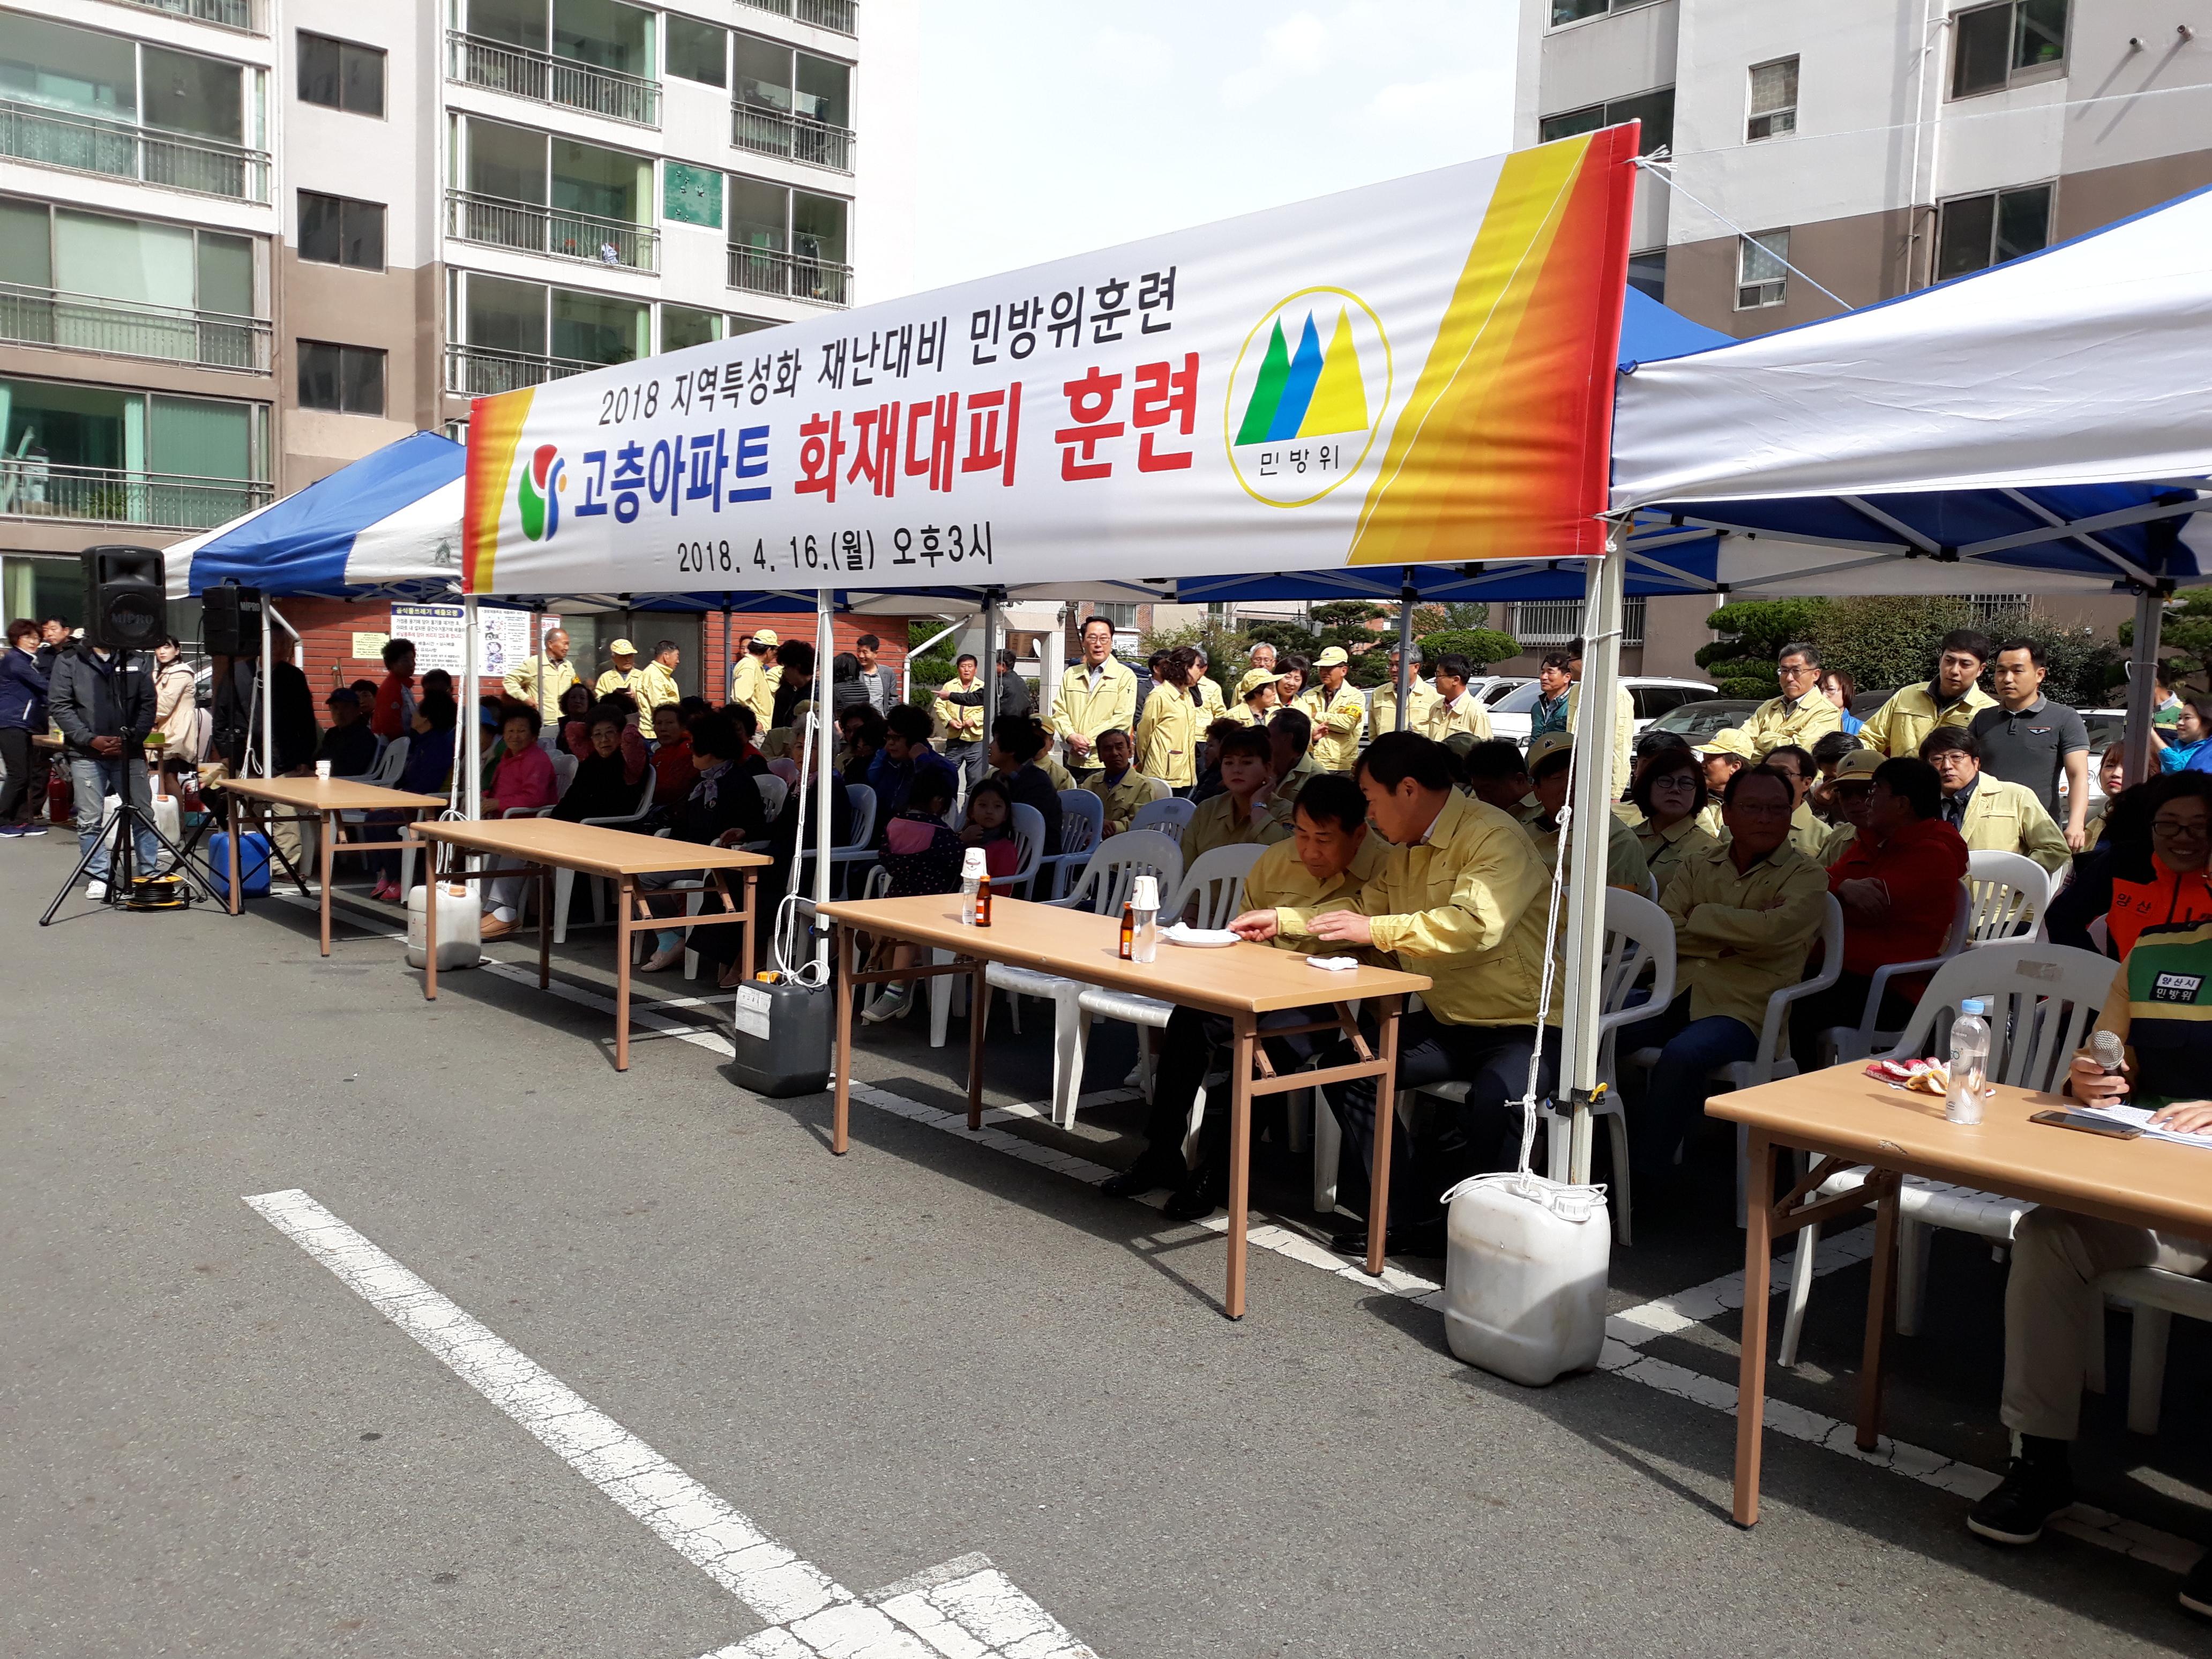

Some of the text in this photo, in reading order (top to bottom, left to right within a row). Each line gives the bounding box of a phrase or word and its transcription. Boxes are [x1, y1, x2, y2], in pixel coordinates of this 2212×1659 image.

[600, 266, 1176, 425] 2018 지역특성화 재난대비 민방위훈련
[575, 352, 1200, 523] 고층아파트 화재대피 훈련
[1260, 445, 1339, 476] 민방위
[677, 521, 992, 573] 2018. 4. 16.(월) 오후3시
[240, 601, 260, 611] MIPRO
[2156, 988, 2193, 1001] 민방위
[2162, 977, 2196, 988] 양산시
